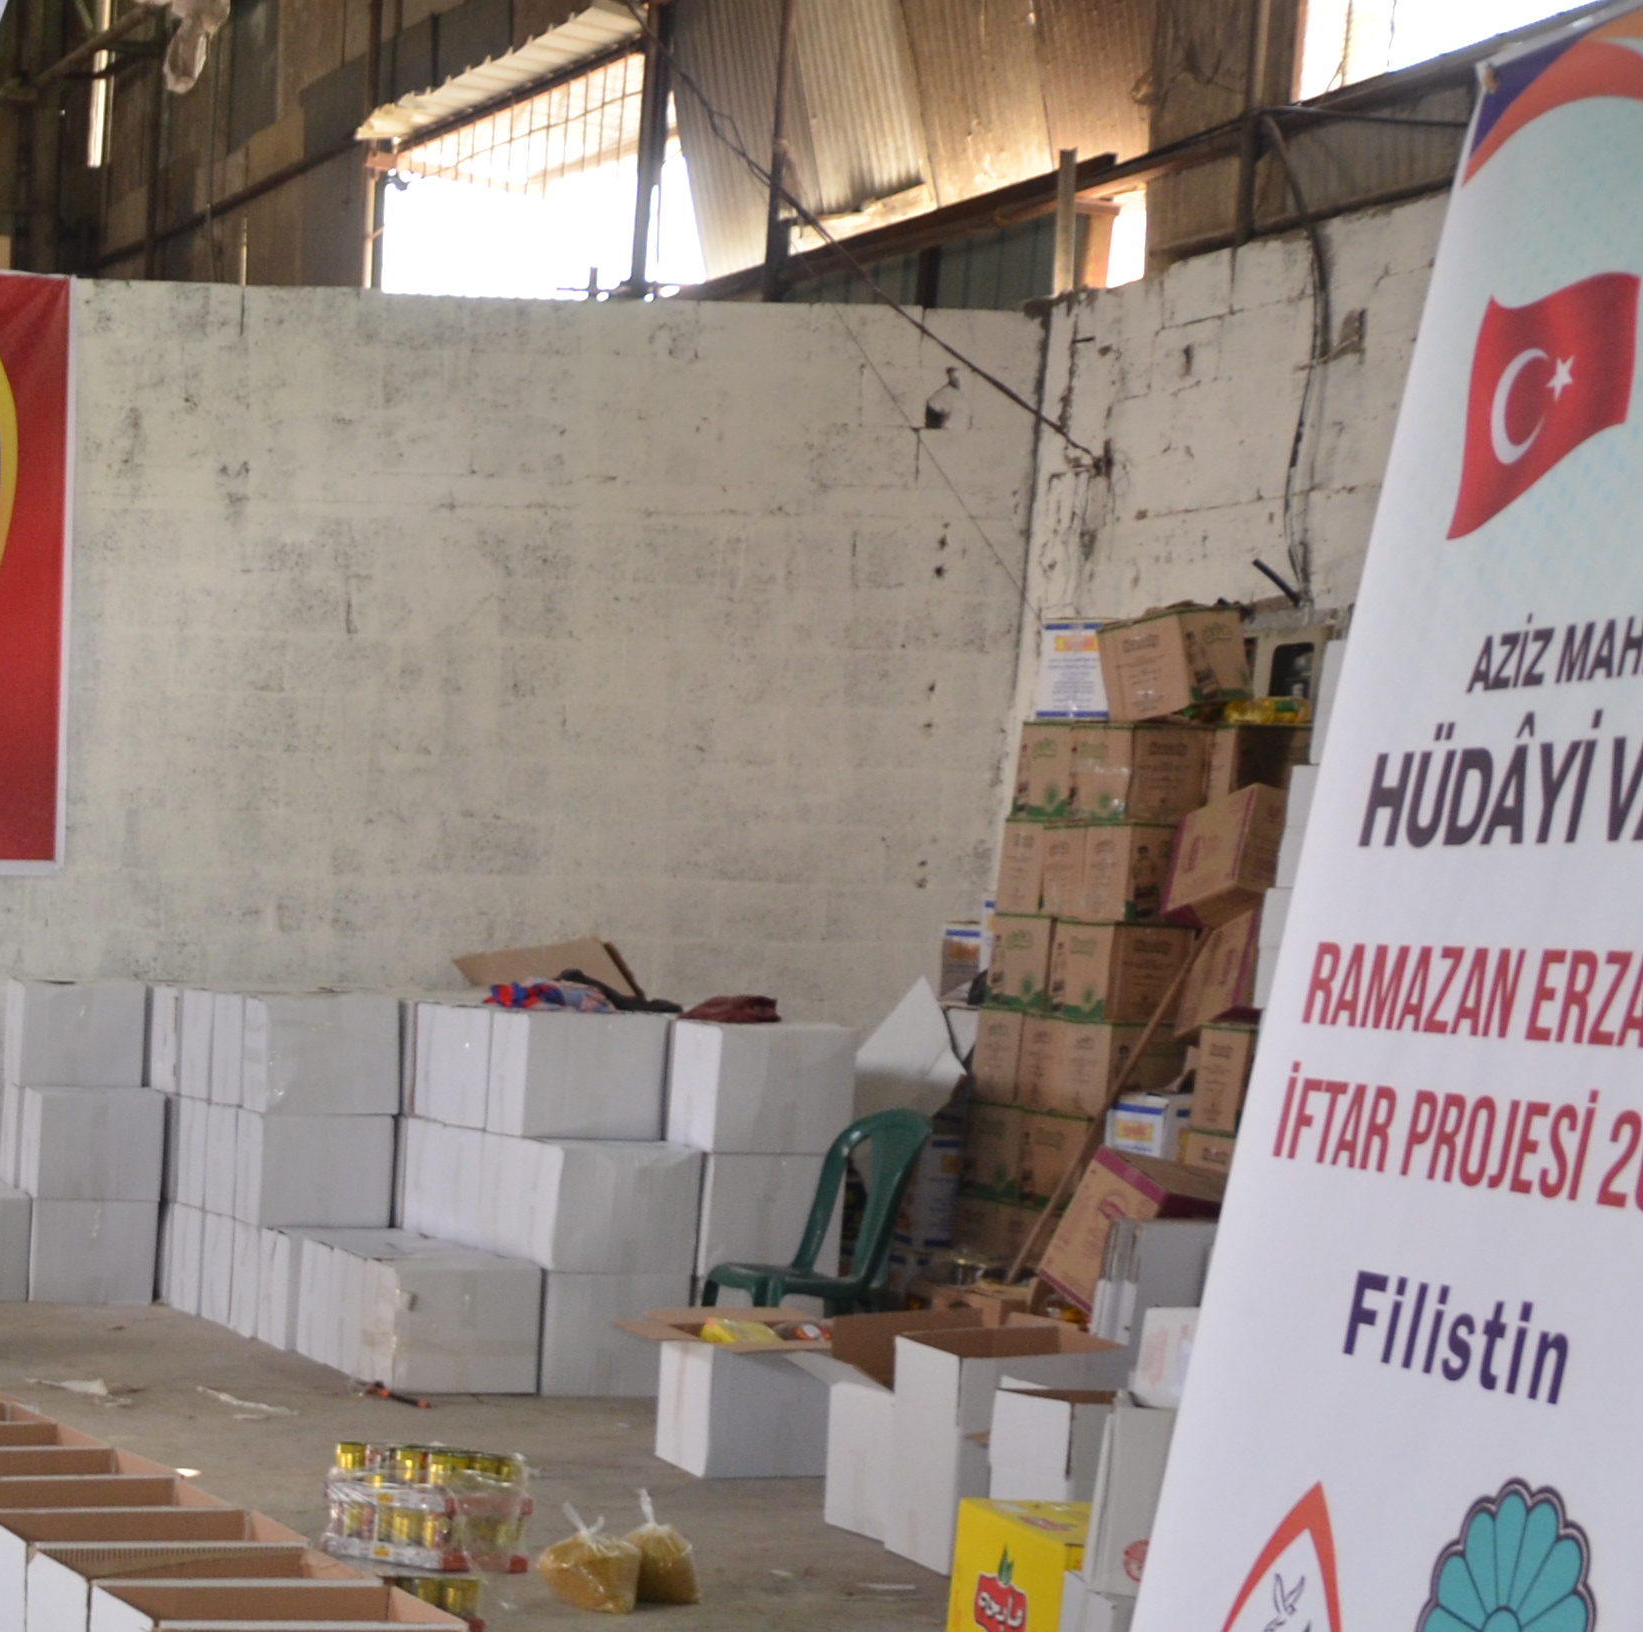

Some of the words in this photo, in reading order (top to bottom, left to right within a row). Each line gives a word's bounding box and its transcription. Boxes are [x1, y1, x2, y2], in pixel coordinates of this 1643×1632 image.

[1466, 612, 1555, 694] AZİZ
[1358, 707, 1604, 849] HÜDÂYİ
[1301, 940, 1526, 1040] RAMAZAN
[1272, 1061, 1397, 1173] İFTAR
[1399, 1088, 1600, 1202] PROJESİ
[1343, 1270, 1569, 1405] Filistin
